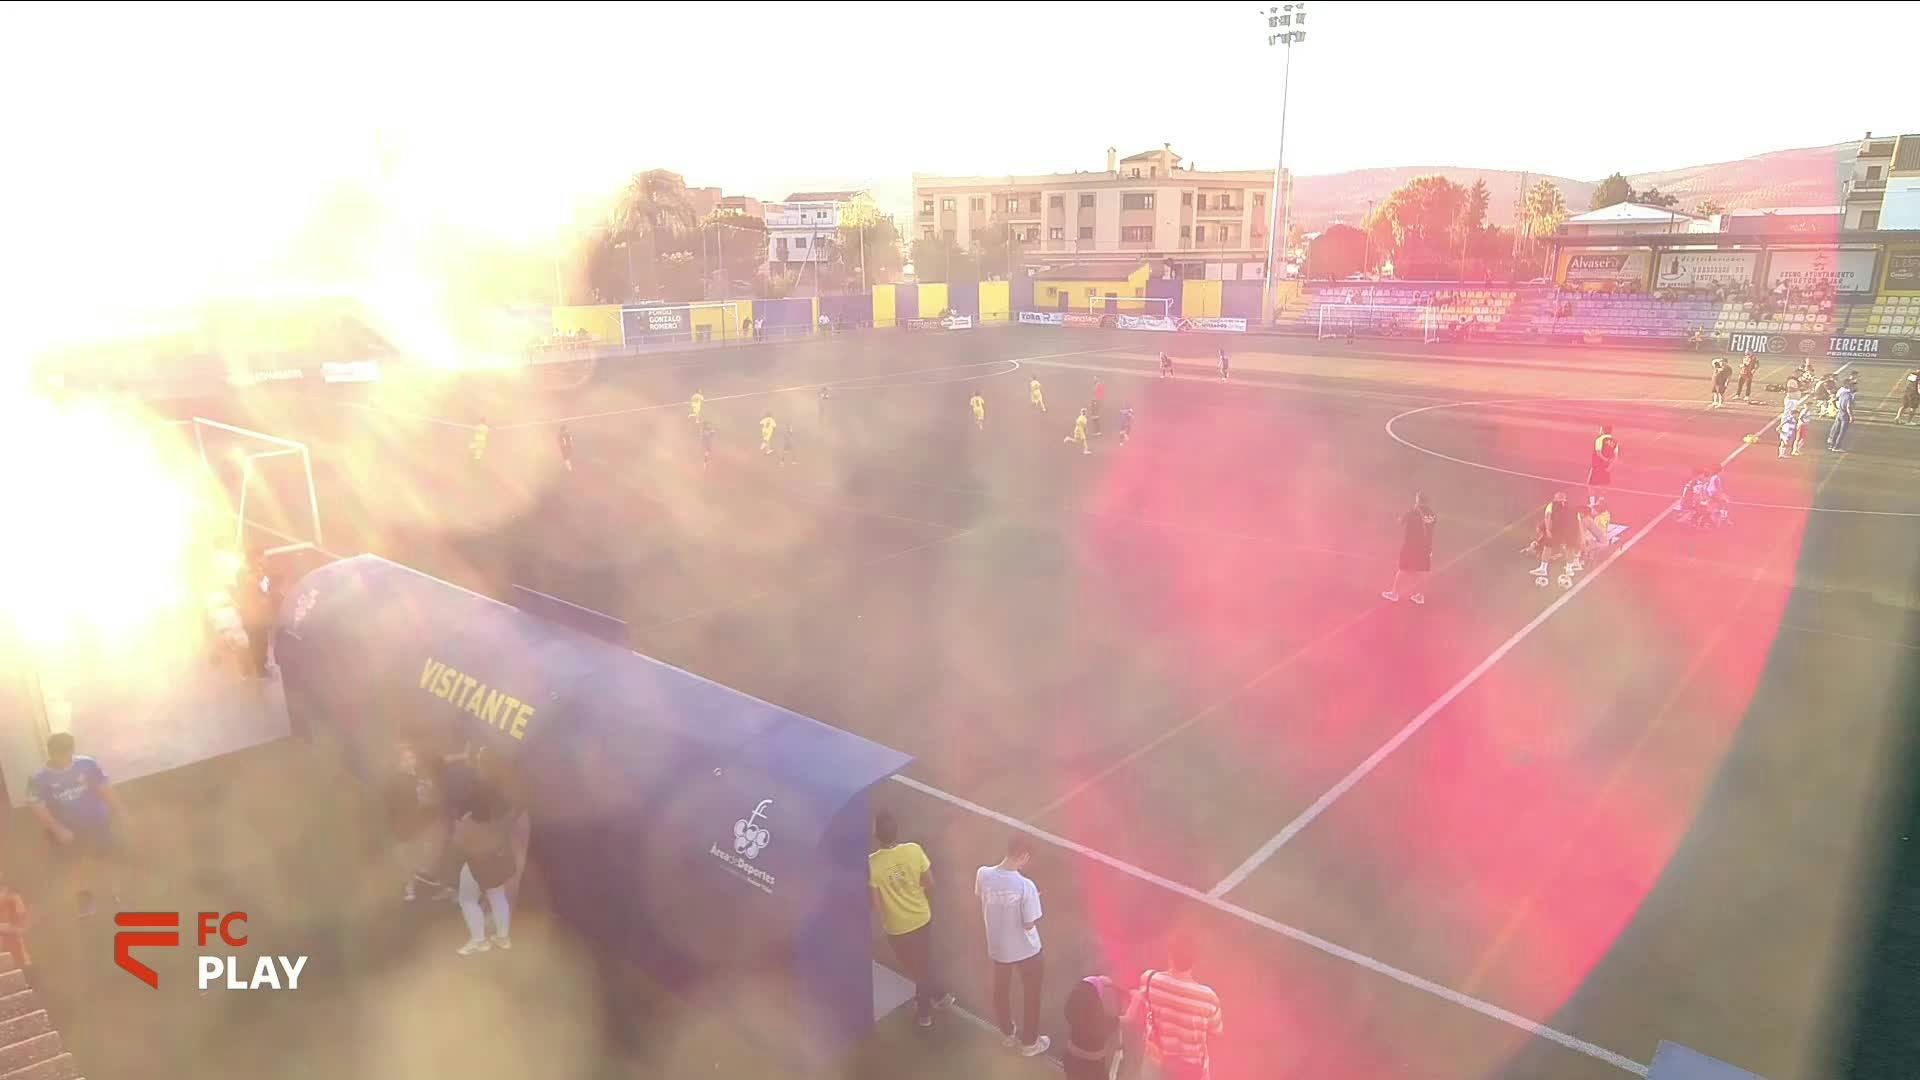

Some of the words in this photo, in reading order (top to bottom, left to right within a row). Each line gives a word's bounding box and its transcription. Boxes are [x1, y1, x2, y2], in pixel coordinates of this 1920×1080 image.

[649, 315, 681, 323] GONZALO
[649, 322, 678, 330] ROMERO
[1829, 337, 1879, 352] TERCERA
[419, 657, 536, 741] VISITANTE
